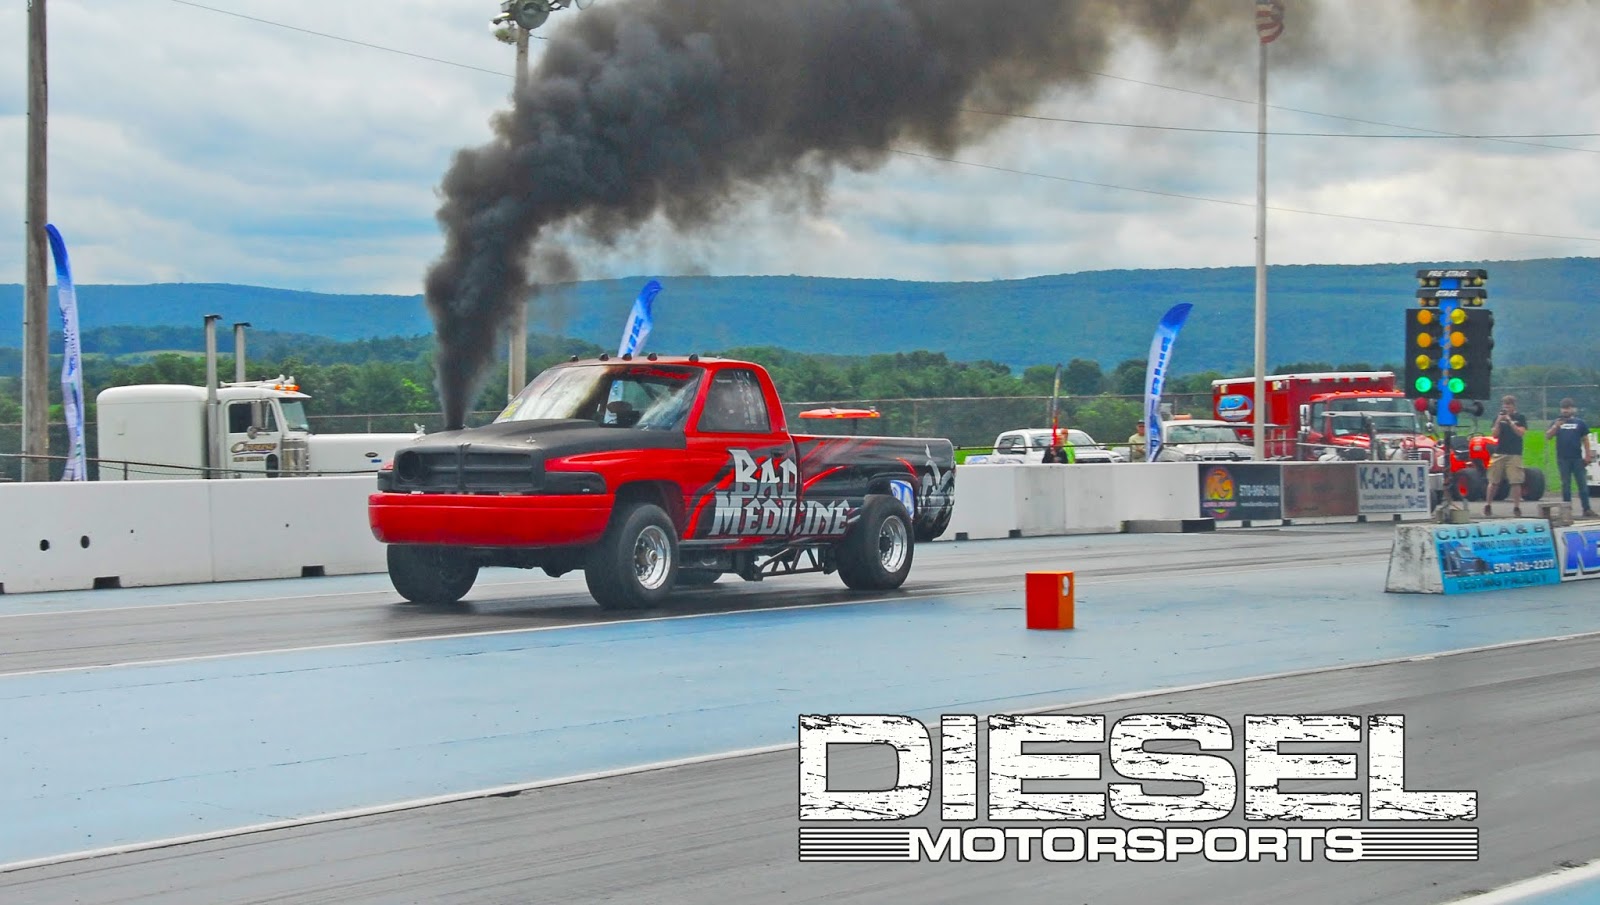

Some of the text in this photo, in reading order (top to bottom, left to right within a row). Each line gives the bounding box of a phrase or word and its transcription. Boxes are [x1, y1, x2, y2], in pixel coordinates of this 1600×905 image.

[728, 449, 798, 499] BAD
[1359, 466, 1394, 490] K-Cab
[1398, 466, 1417, 490] Co.
[708, 489, 852, 536] MEDICINE
[1498, 524, 1512, 536] A
[1515, 524, 1529, 535] &
[1533, 523, 1546, 534] B
